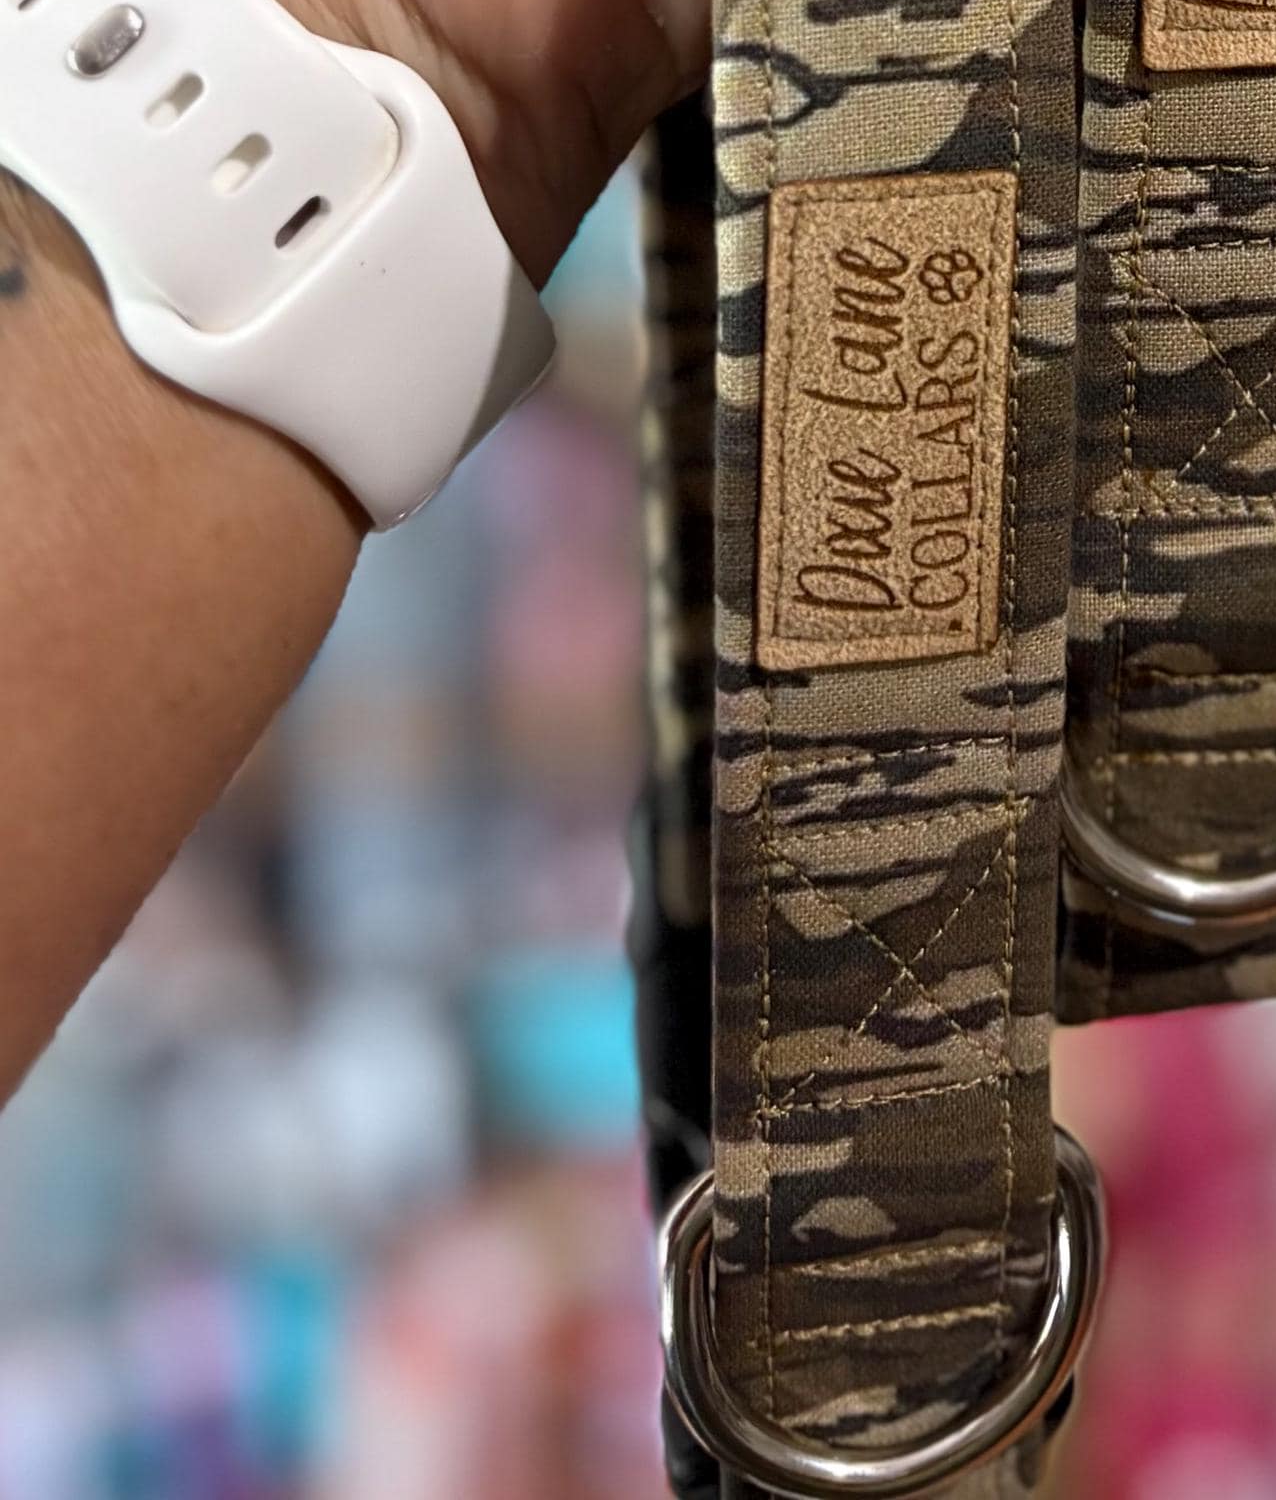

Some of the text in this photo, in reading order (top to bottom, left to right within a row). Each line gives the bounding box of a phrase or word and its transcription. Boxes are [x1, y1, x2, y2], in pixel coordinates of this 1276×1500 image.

[793, 235, 909, 612] Dixie Lane
[907, 330, 981, 611] COLLARS
